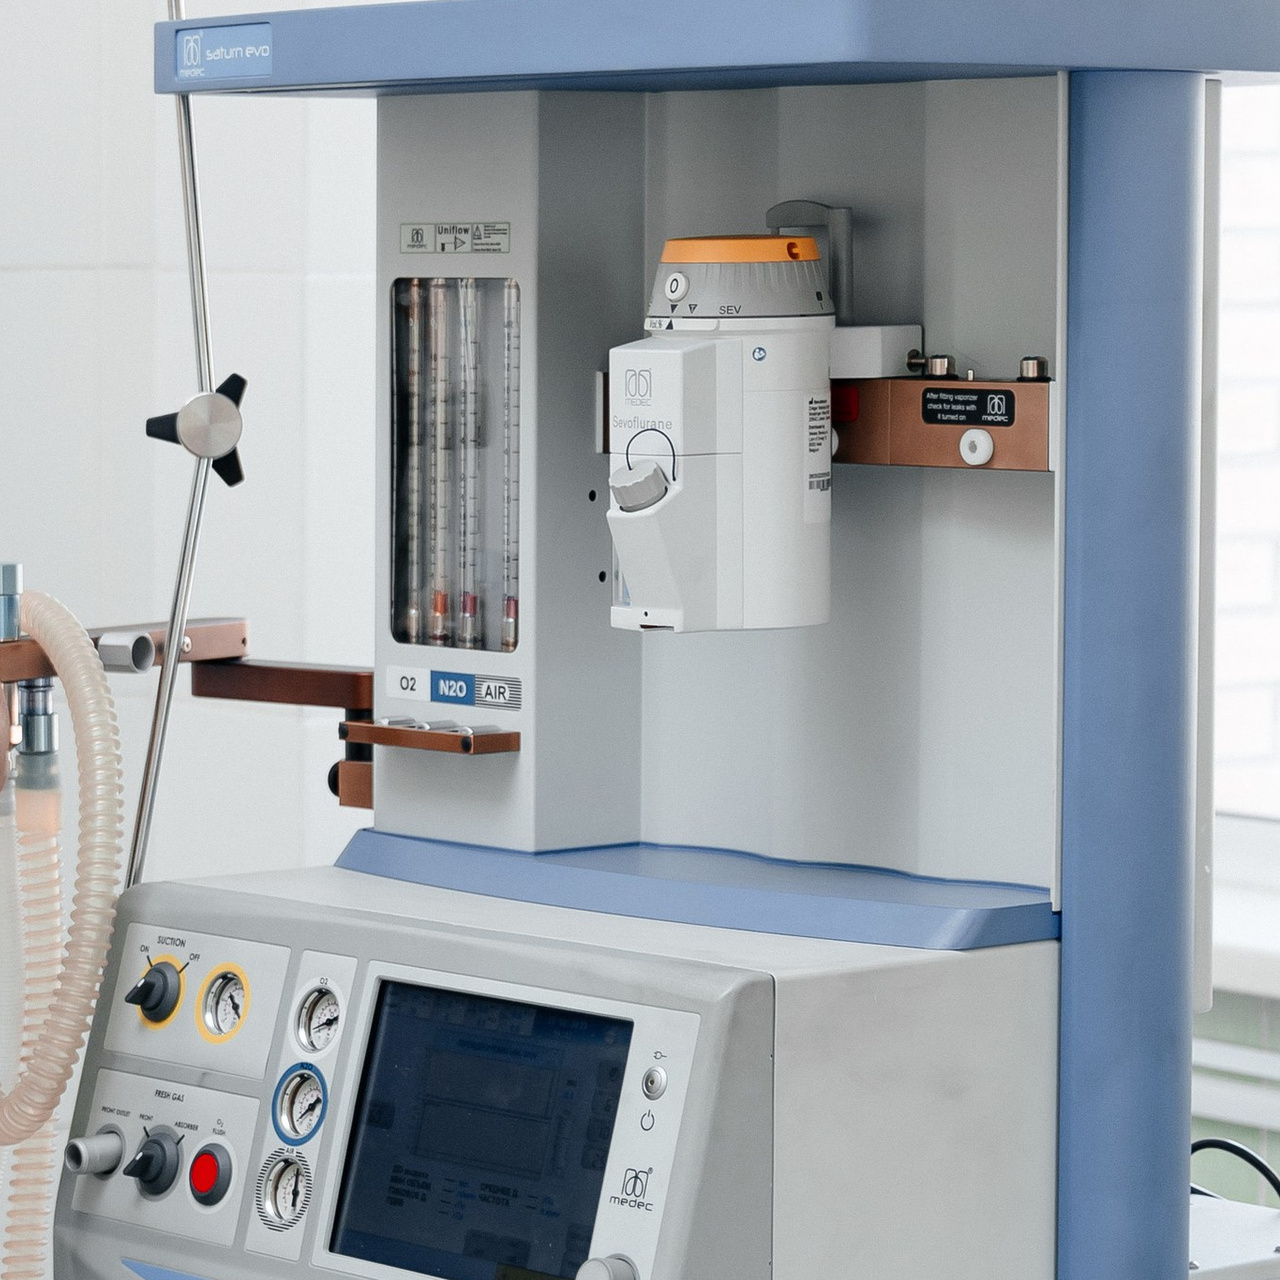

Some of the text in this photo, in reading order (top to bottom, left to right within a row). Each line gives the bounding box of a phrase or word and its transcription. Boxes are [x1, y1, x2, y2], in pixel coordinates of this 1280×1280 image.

[206, 45, 270, 61] saturn evo
[438, 226, 470, 235] Uniflow
[719, 306, 742, 315] SEV
[926, 392, 939, 400] After
[954, 394, 978, 402] vaporizer
[612, 415, 673, 430] Sevoflurane
[982, 414, 1008, 422] medec
[400, 676, 417, 692] O2
[438, 680, 467, 698] N2O
[484, 685, 508, 701] AIR
[157, 936, 186, 948] SUCTION
[140, 944, 150, 952] ON
[189, 953, 200, 962] OFF
[320, 977, 328, 985] O2
[154, 1089, 184, 1102] FRESH GAS
[174, 1121, 200, 1132] ABSORBER
[609, 1196, 654, 1212] medec
